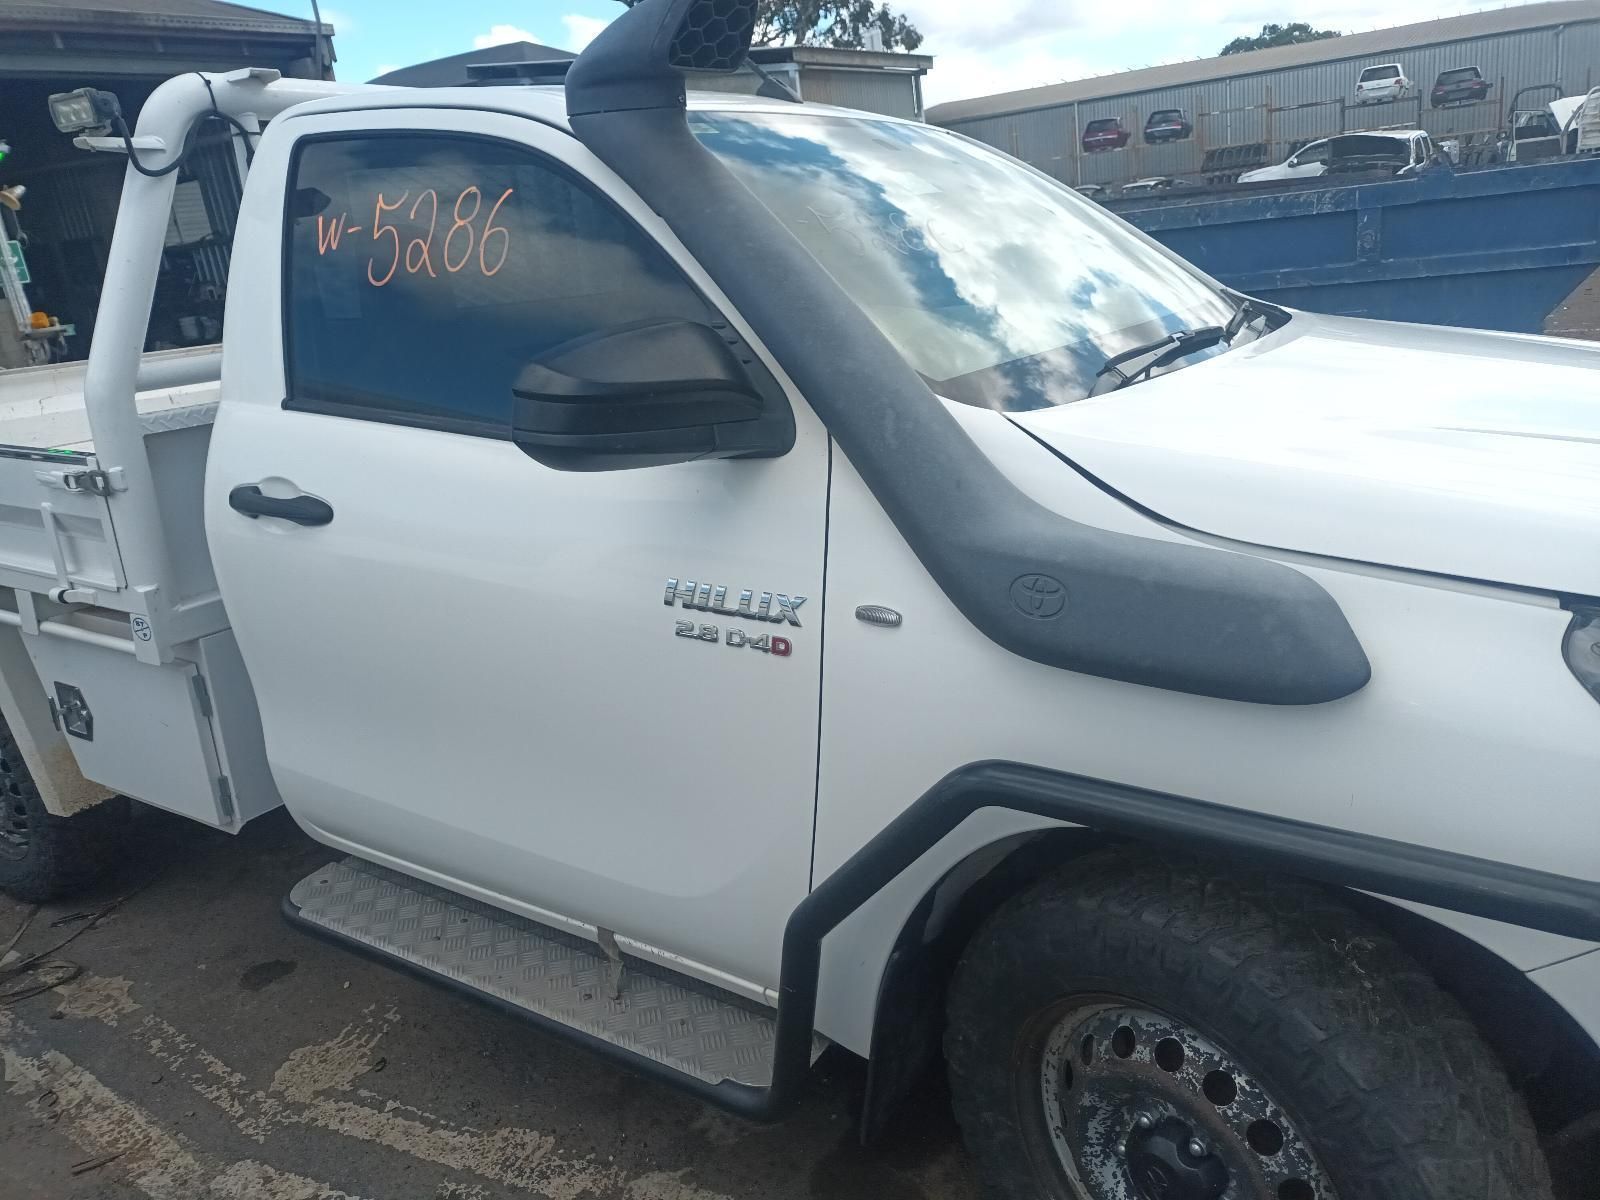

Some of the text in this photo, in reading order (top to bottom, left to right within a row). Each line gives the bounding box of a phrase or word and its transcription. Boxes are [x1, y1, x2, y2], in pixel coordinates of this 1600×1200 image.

[663, 577, 808, 628] HILUX
[675, 619, 793, 657] 2.8 D-4D
